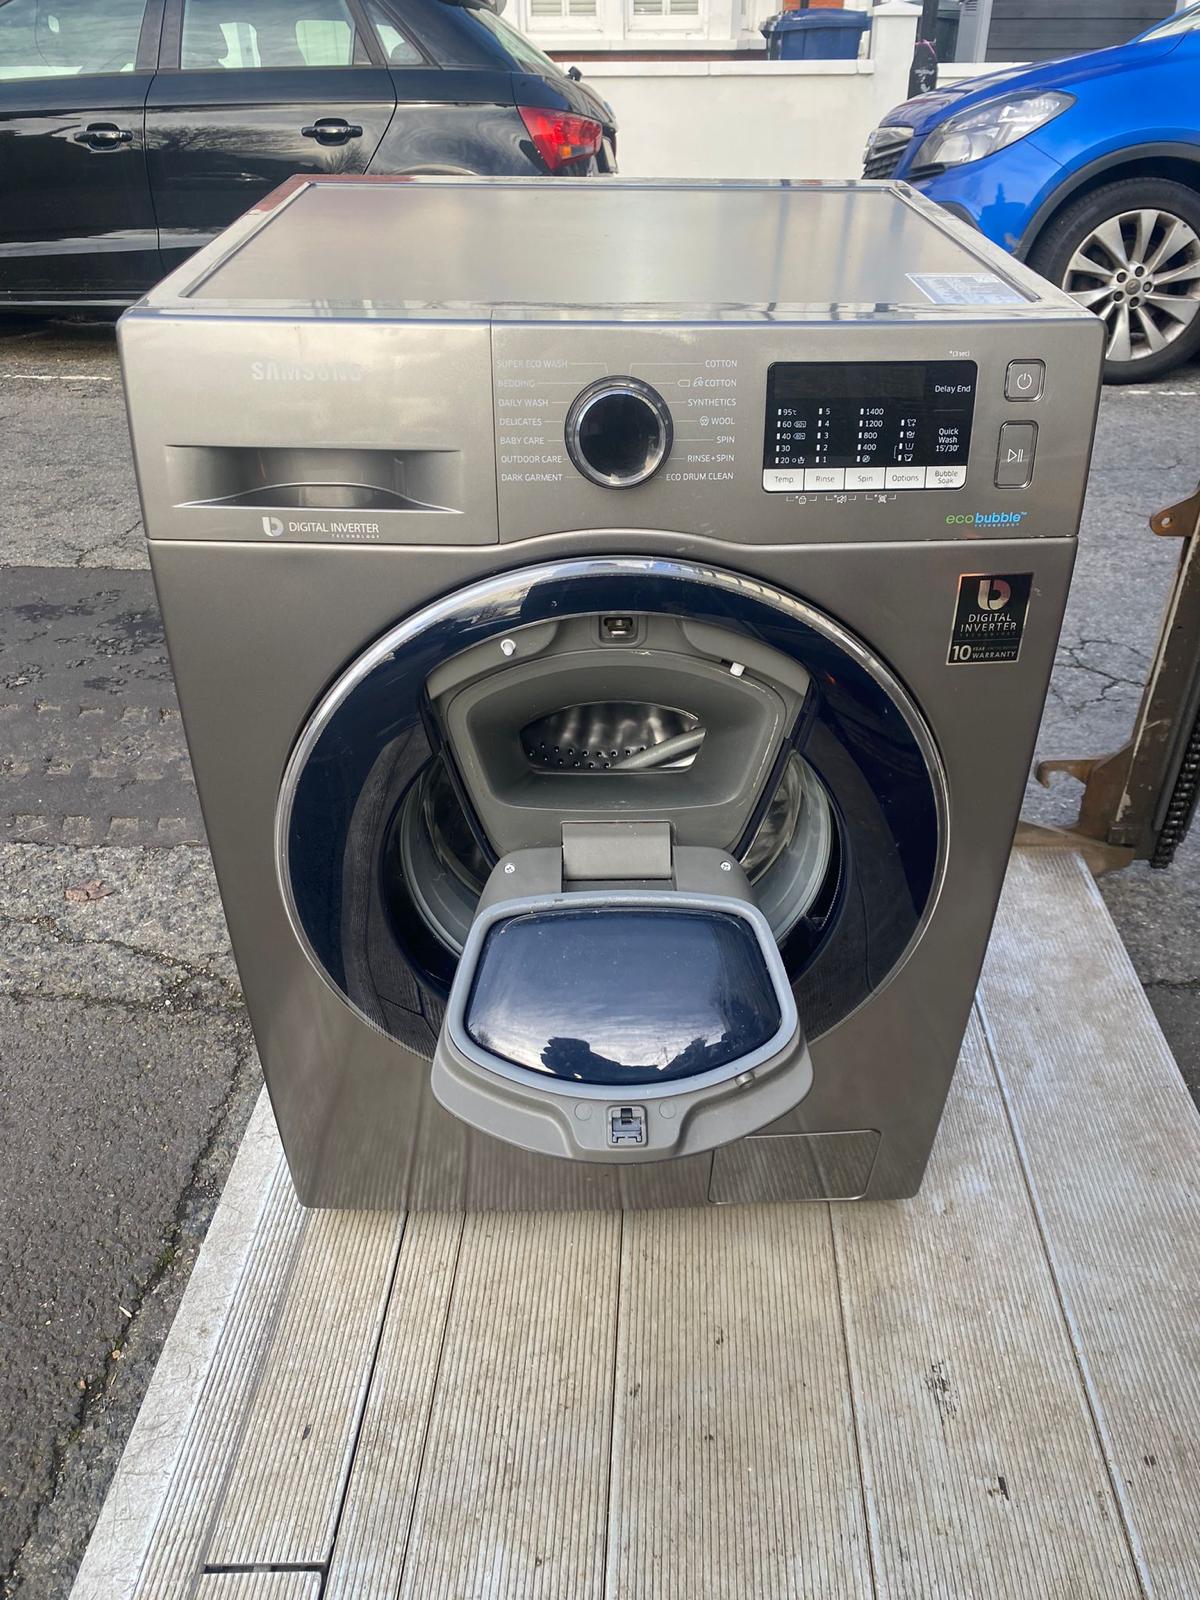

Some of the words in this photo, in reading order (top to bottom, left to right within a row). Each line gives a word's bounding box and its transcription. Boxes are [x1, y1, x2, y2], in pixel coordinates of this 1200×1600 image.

[495, 360, 524, 368] SUPER
[525, 360, 542, 368] ECO
[543, 360, 568, 368] WASH
[705, 359, 738, 368] COTTON
[497, 379, 536, 388] BEDDING
[704, 378, 737, 387] COTTON
[934, 384, 956, 394] Delay
[957, 384, 971, 393] End
[498, 399, 522, 407] DAILY
[523, 399, 549, 407] WASH
[687, 398, 737, 407] SYNTHETICS
[866, 408, 885, 416] 1400
[499, 418, 542, 426] DELICATES
[711, 416, 736, 425] WOOL
[865, 420, 884, 428] 1200
[781, 432, 792, 440] 40
[938, 427, 959, 436] Quick
[500, 437, 522, 445] BABY
[523, 437, 545, 445] CARE
[716, 435, 735, 444] SPIN
[938, 436, 958, 444] Wash
[780, 444, 791, 452] 30
[862, 443, 877, 451] 400
[500, 455, 540, 464] OUTDOOR
[541, 455, 563, 464] CARE
[687, 454, 735, 463] RINSE+SPIN
[780, 456, 790, 464] 20
[501, 473, 523, 482] DARK
[524, 473, 563, 482] GARMENT
[666, 473, 682, 481] ECO
[682, 472, 707, 481] DRUM
[708, 472, 734, 480] CLEAN
[774, 475, 794, 484] Temp
[815, 475, 835, 483] Rinse
[857, 475, 873, 484] Spin
[891, 474, 919, 482] Options
[288, 521, 329, 533] DIGITAL
[330, 522, 380, 534] INVERTER
[968, 612, 1012, 623] DIGITAL
[960, 622, 1017, 633] INVERTER
[952, 644, 972, 661] 10
[972, 650, 1016, 659] WARRANTY
